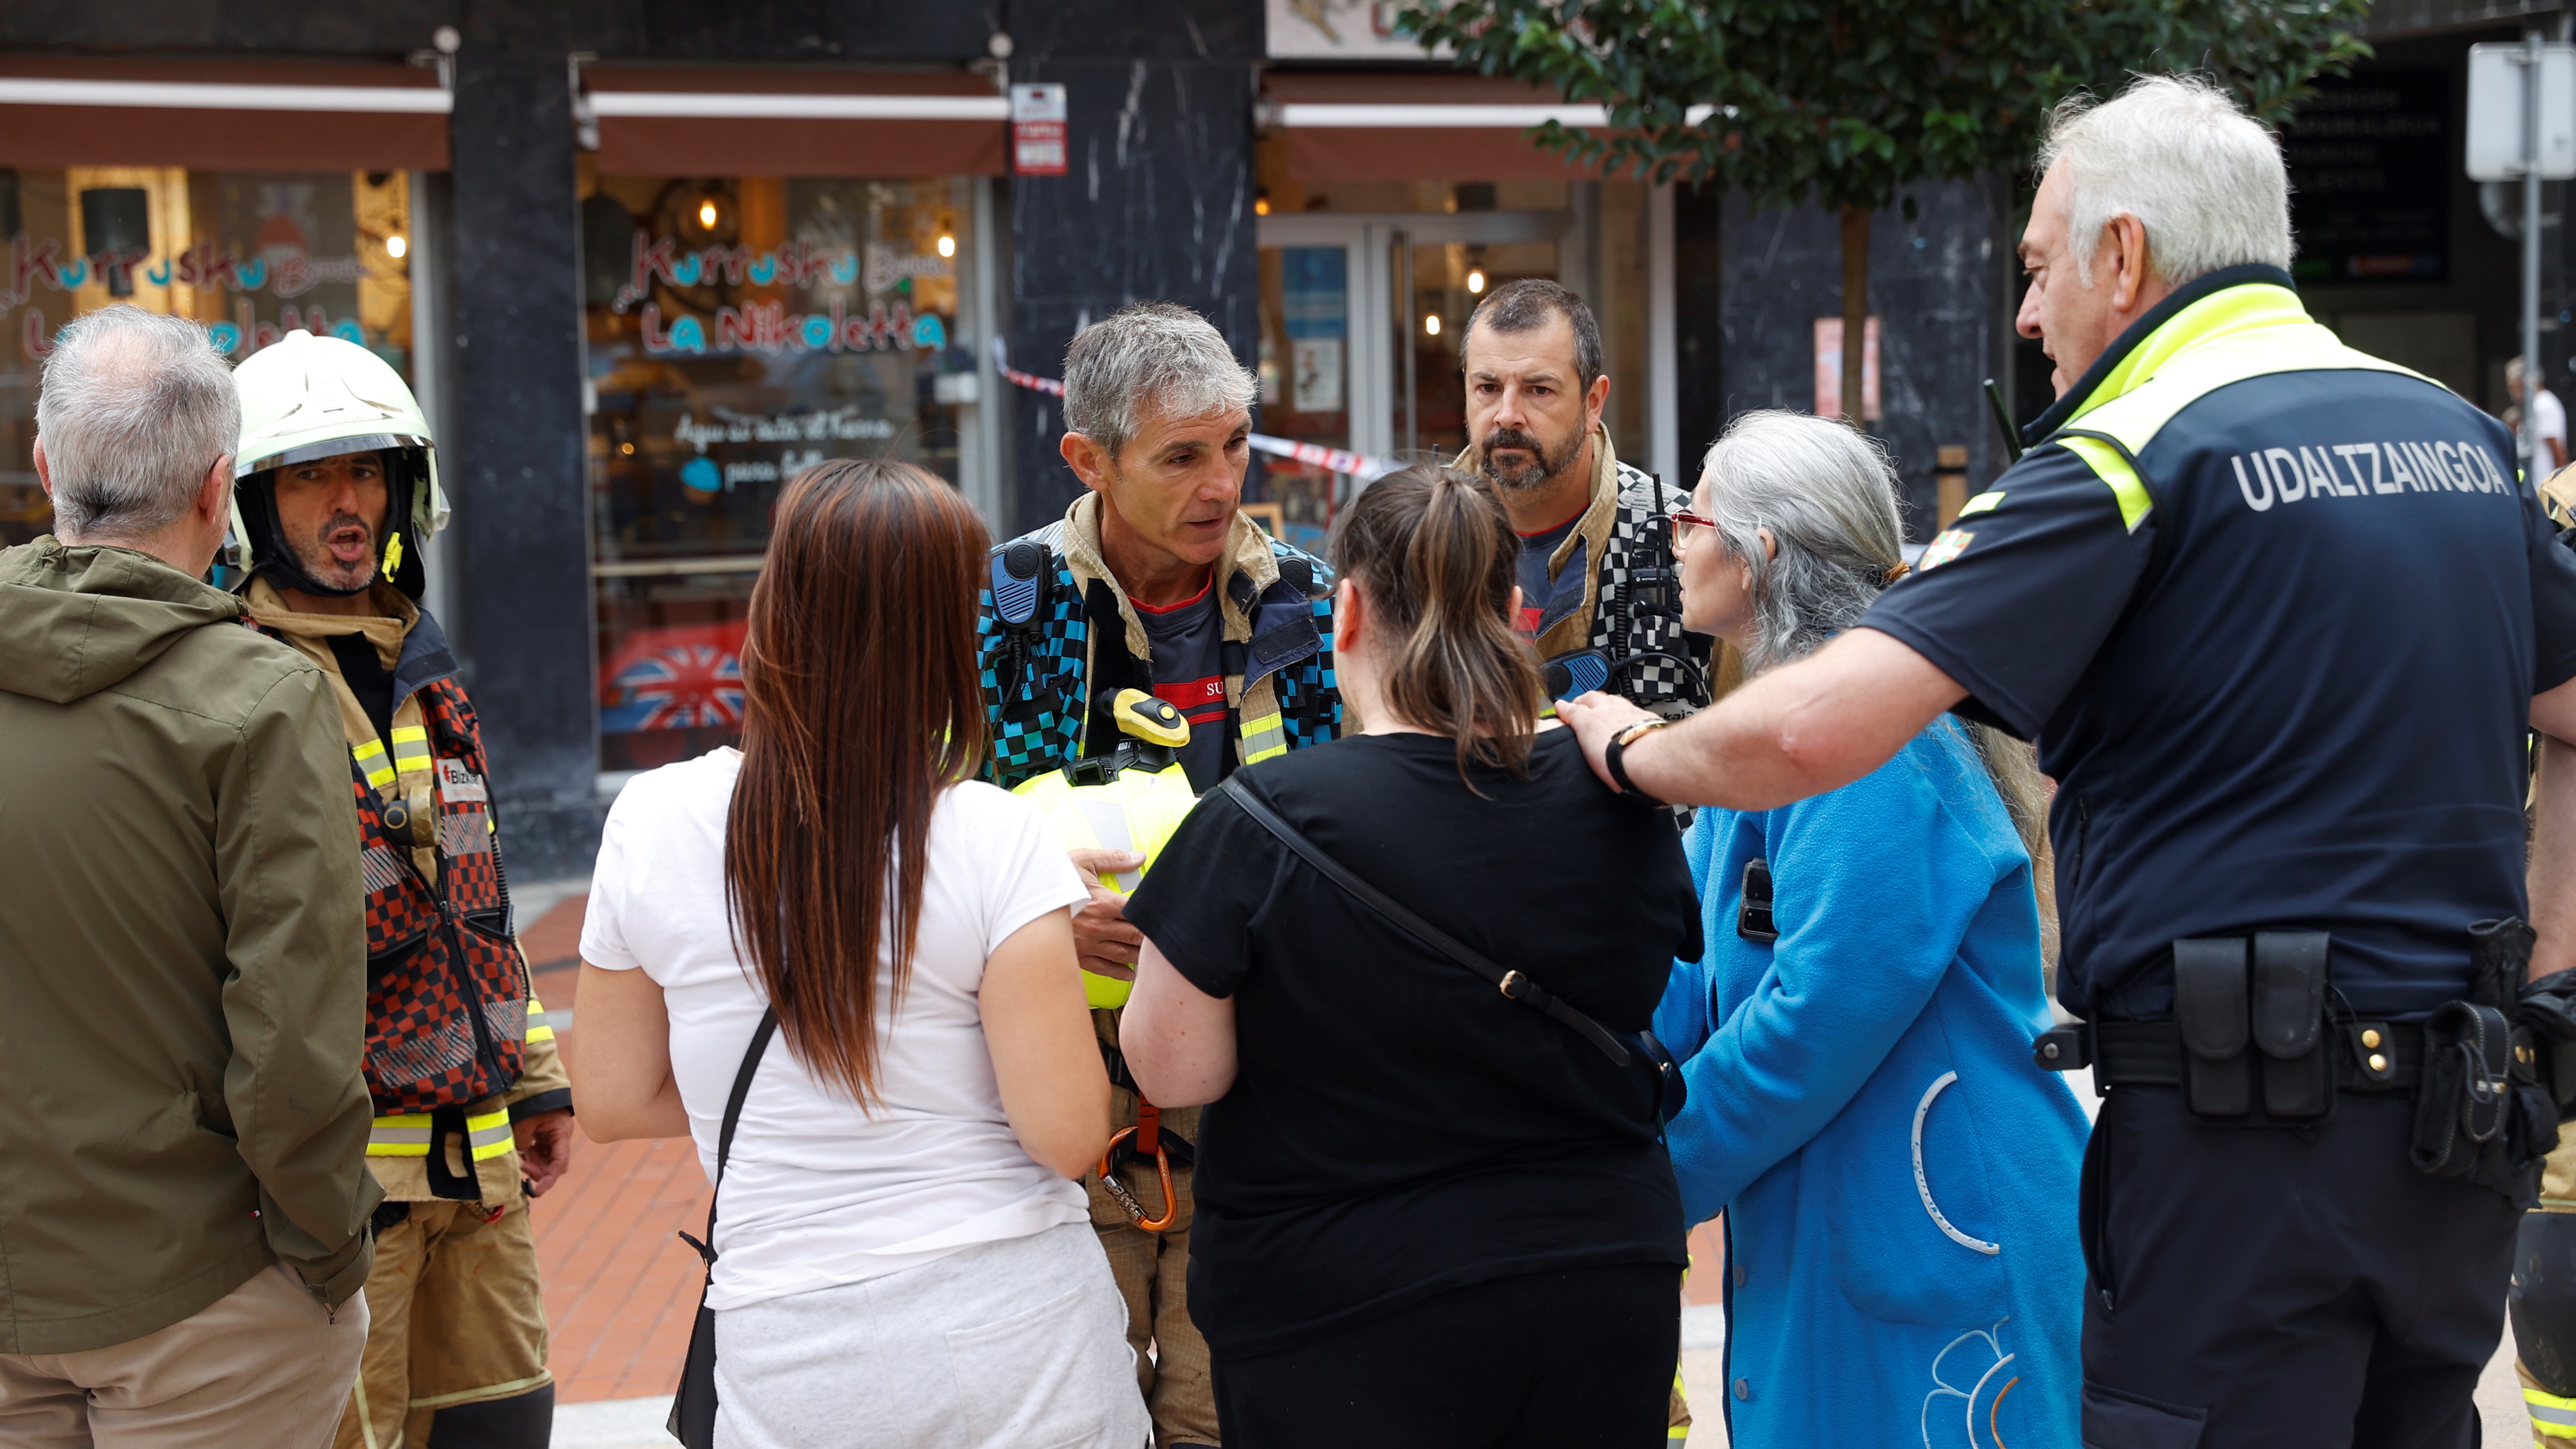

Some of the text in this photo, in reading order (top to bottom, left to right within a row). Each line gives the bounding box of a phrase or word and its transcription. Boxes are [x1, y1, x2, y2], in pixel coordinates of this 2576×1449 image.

[630, 228, 860, 299] Kurrusku
[641, 291, 947, 356] La Nikoletta
[2230, 441, 2511, 512] UDALTZAINGOA
[1207, 681, 1226, 696] SU
